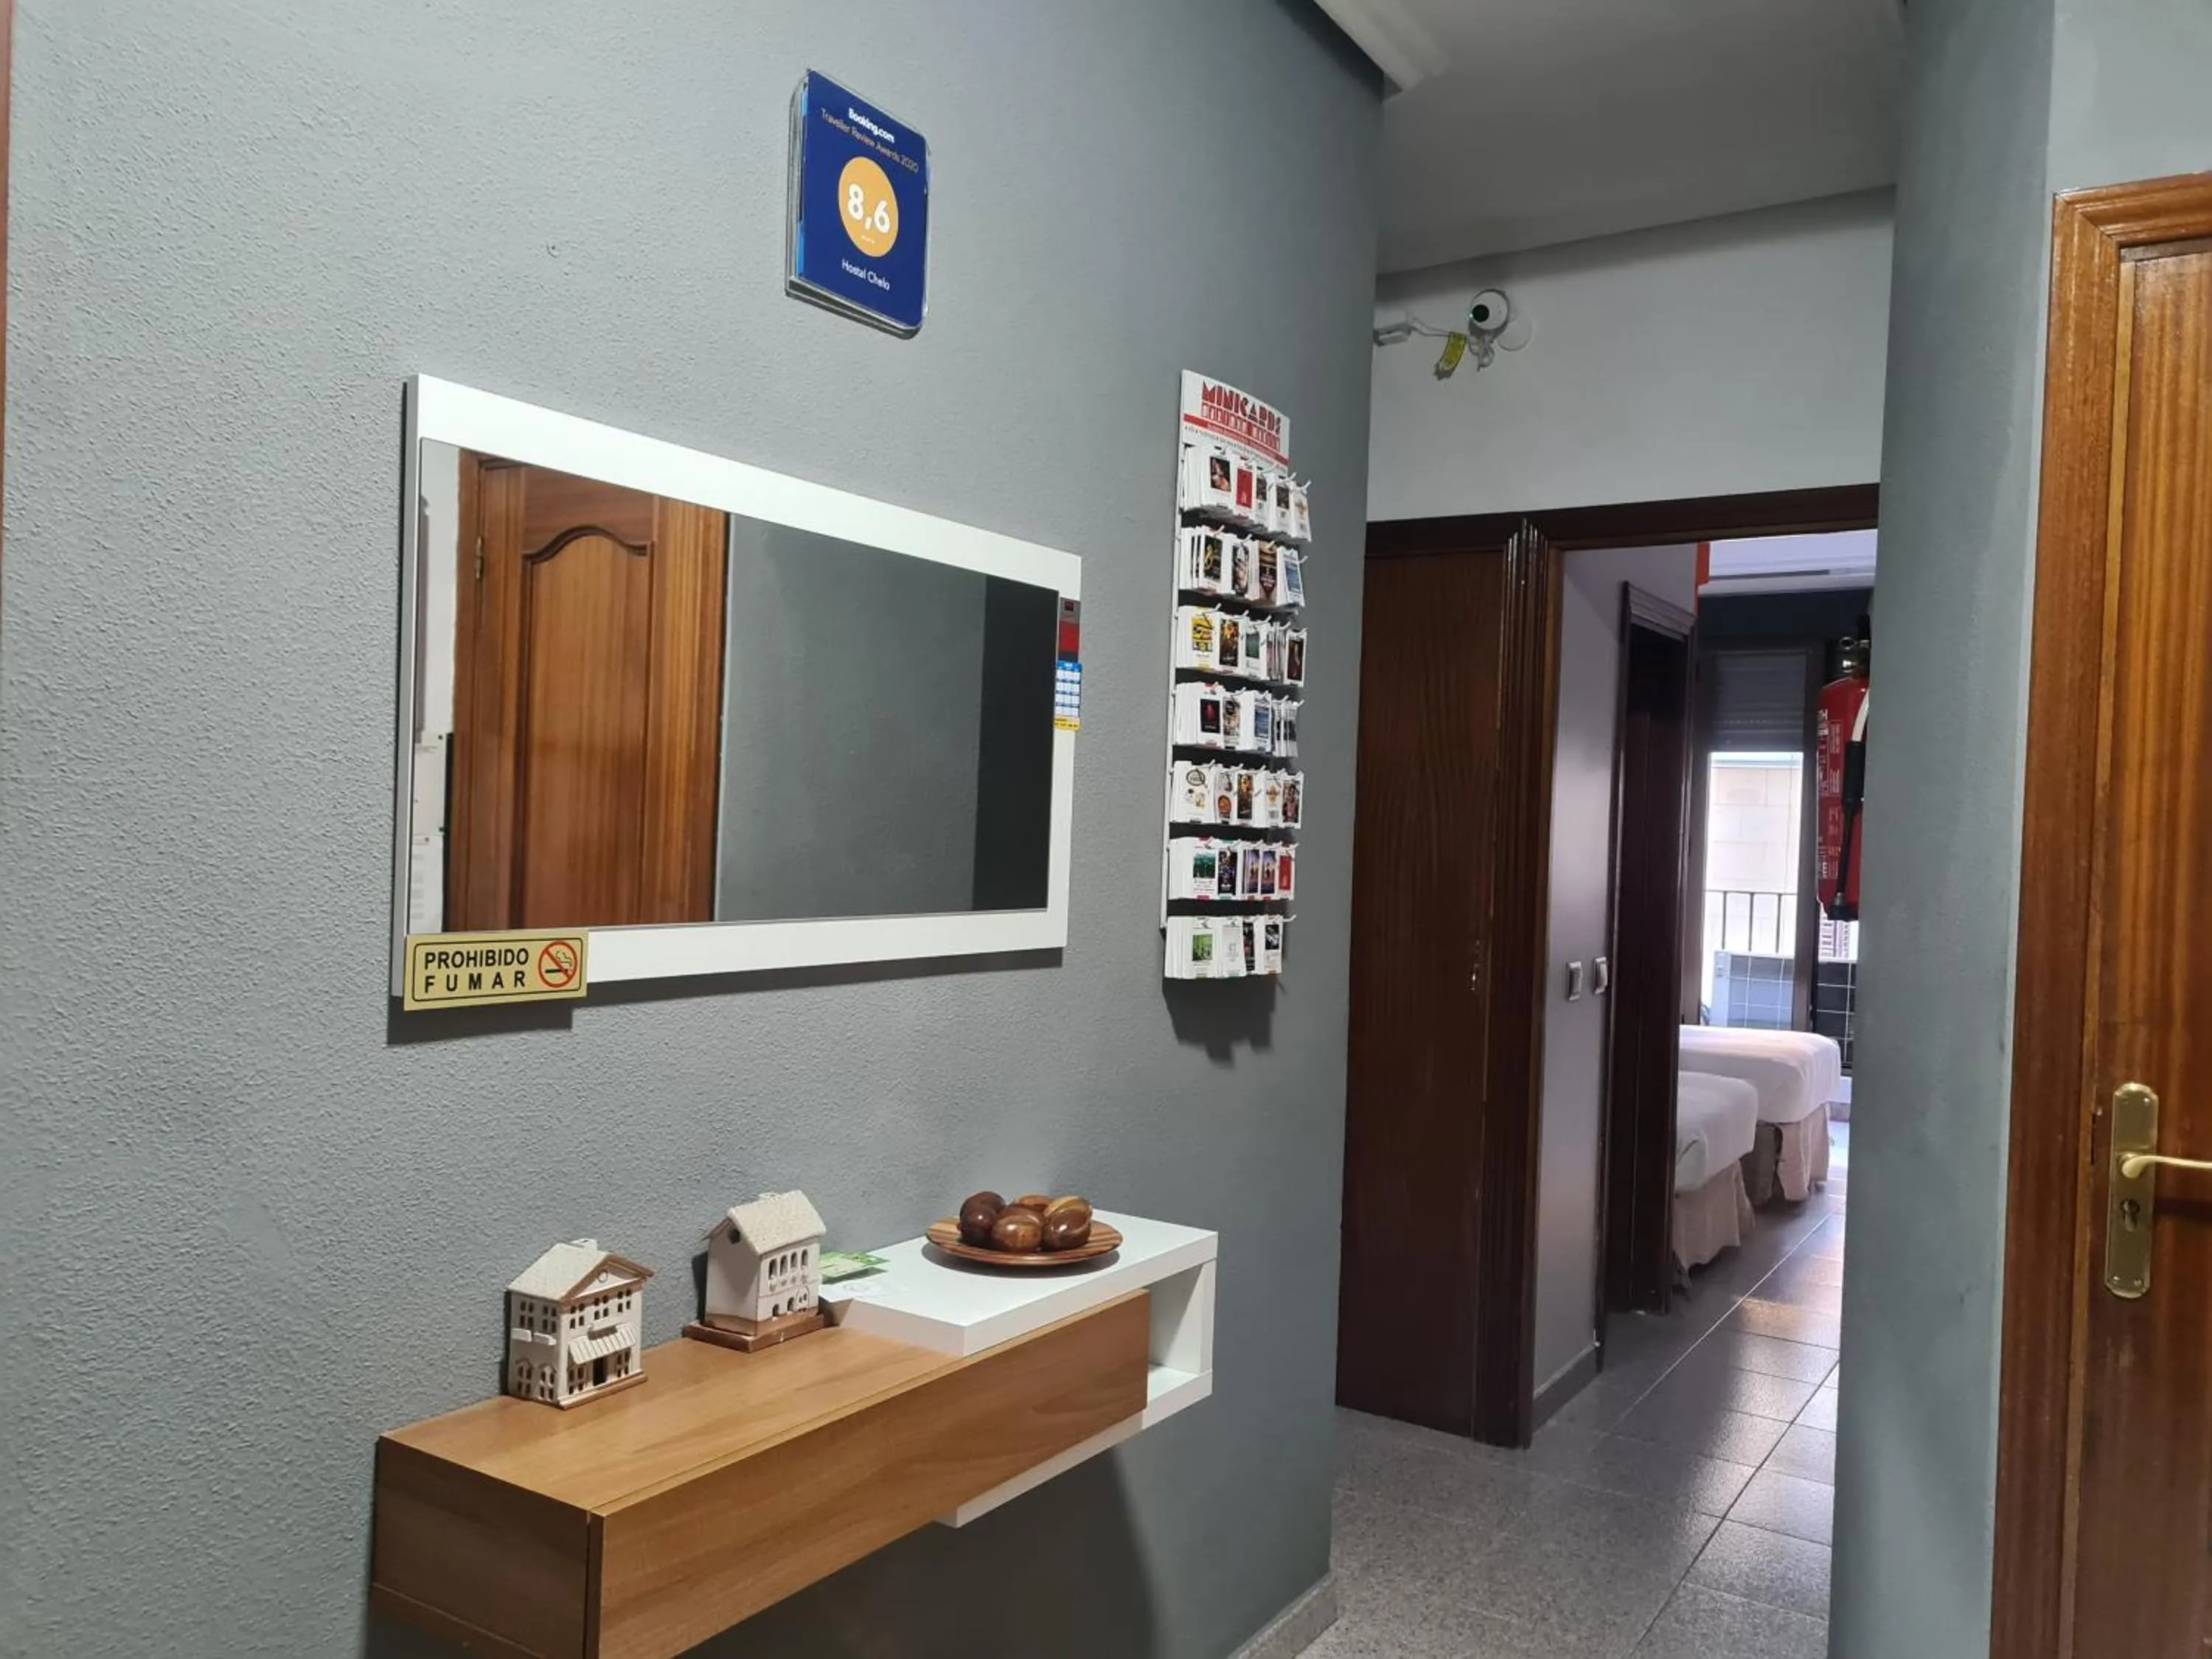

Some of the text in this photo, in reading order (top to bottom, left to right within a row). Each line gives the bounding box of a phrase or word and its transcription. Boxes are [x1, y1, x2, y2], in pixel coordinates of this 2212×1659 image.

[849, 107, 895, 144] Booking.com
[900, 153, 919, 173] 2020
[848, 183, 891, 233] 8,6
[841, 259, 891, 291] Hostal Chelo
[424, 947, 529, 970] PROHIBIDO
[424, 970, 526, 993] FUMAR
